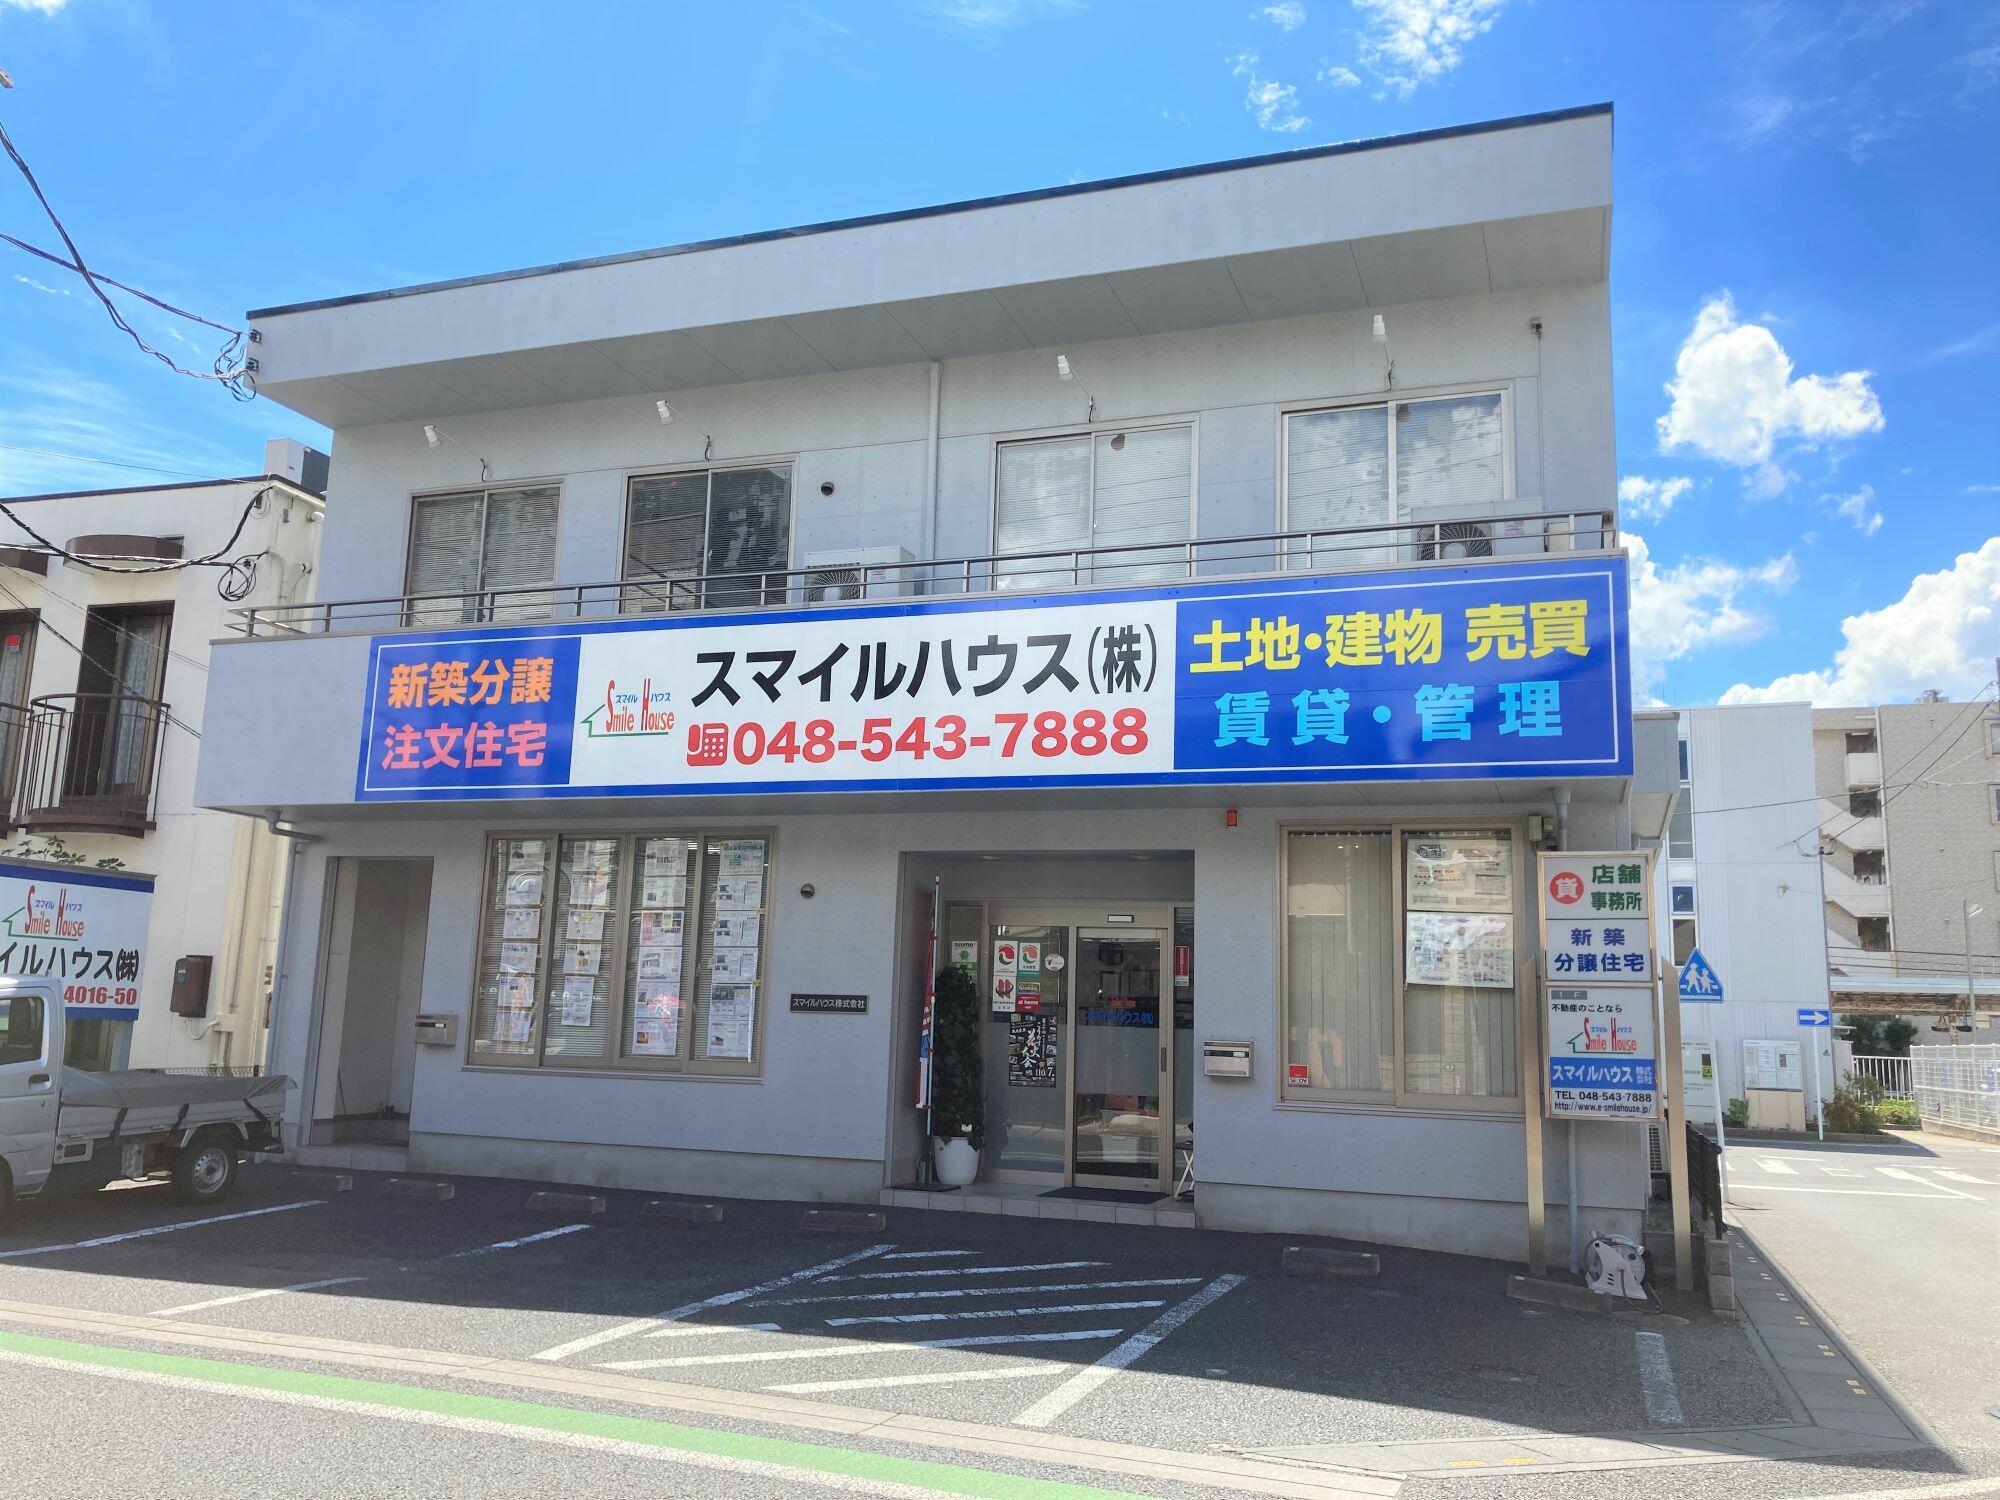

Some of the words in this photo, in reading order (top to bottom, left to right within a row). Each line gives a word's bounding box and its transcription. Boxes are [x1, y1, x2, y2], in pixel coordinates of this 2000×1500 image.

[1190, 608, 1442, 674] 土地・建物
[1465, 599, 1590, 661] 売買
[388, 657, 554, 709] 新築分譲
[606, 679, 635, 733] Smile
[640, 678, 675, 731] House
[615, 694, 639, 704] スマイル
[650, 692, 672, 702] ハウス
[1213, 680, 1563, 748] 賃貸・管理
[382, 722, 548, 771] 注文住宅
[733, 709, 1149, 766] 048-543-7888
[1591, 864, 1642, 885] 店舗
[1556, 878, 1579, 899] 貸
[25, 885, 51, 934] Smile
[55, 888, 85, 937] House
[1590, 891, 1643, 912] 事務所
[1570, 927, 1626, 946] 新築
[1554, 953, 1645, 973] 分譲住宅
[64, 985, 138, 1005] 4016-50
[792, 998, 865, 1009] スマイルハウス株式会社
[1551, 1003, 1623, 1013] 不動産のことなら
[1584, 1017, 1607, 1051] Smile
[1610, 1018, 1637, 1051] House
[1552, 1064, 1633, 1083] スマイルハウス
[1555, 1091, 1575, 1100] TEL
[1579, 1091, 1652, 1102] 048-543-7888
[1554, 1101, 1652, 1114] http://www.e-smilehouse.jp/
